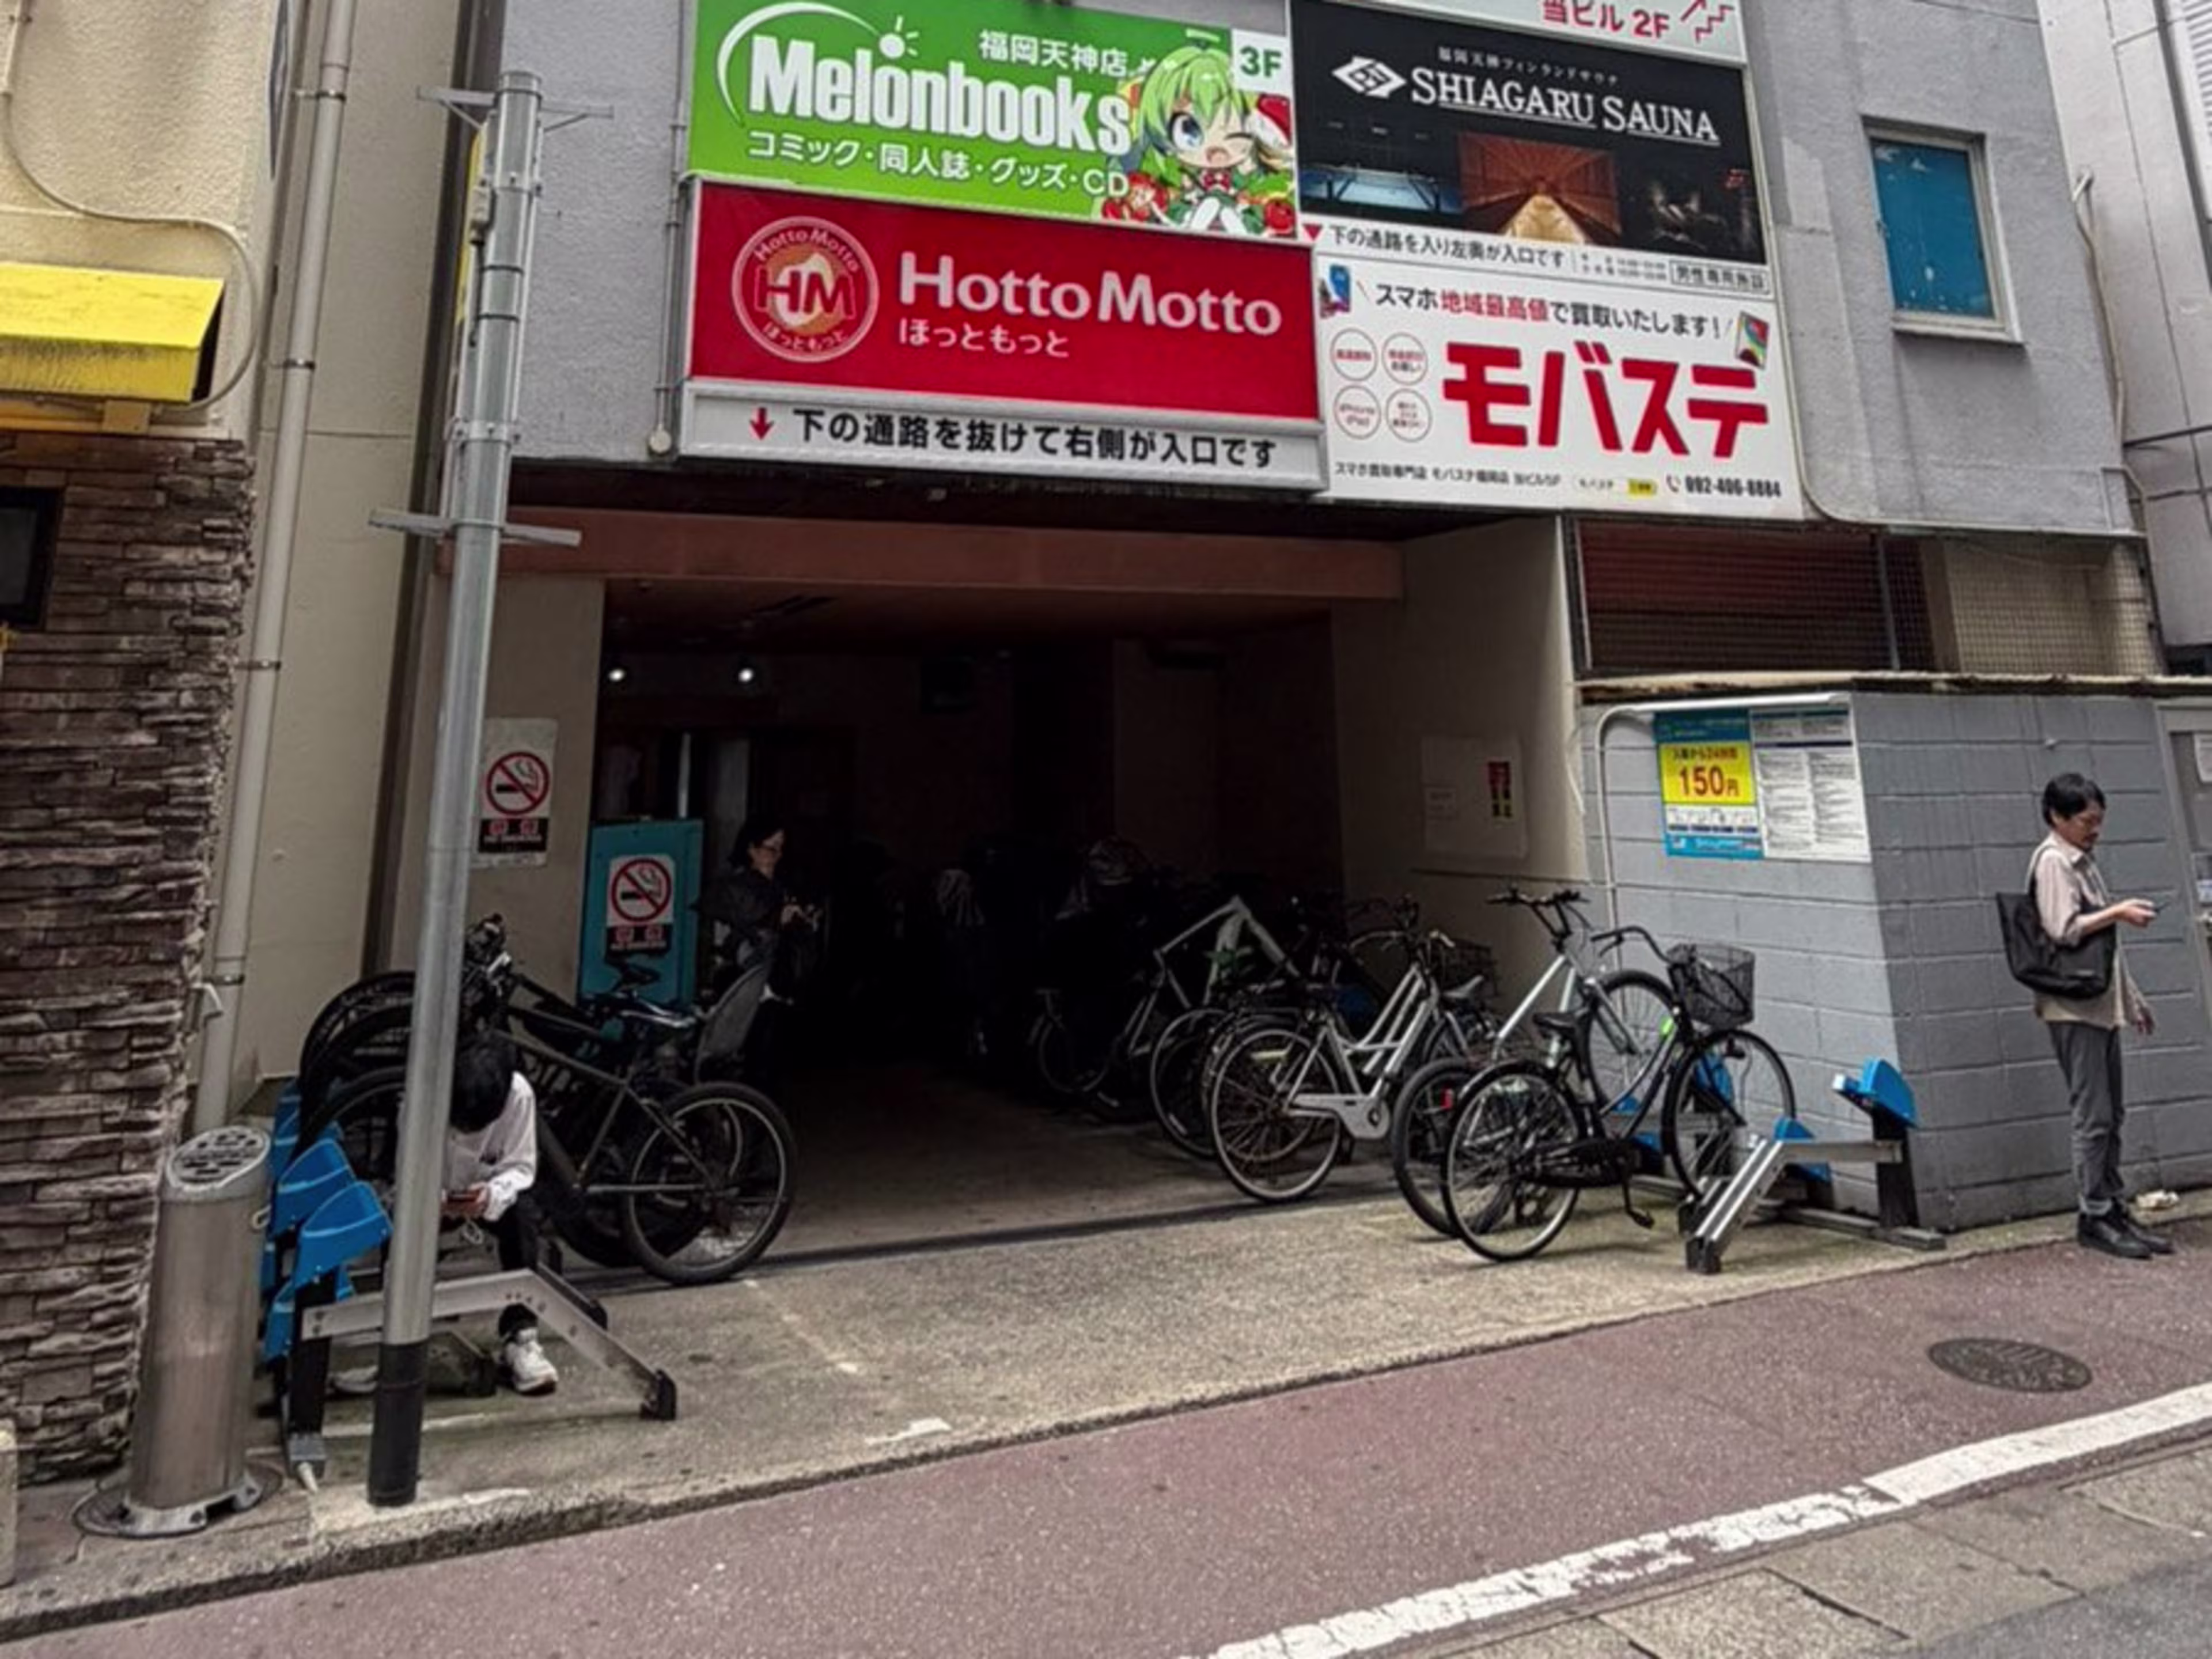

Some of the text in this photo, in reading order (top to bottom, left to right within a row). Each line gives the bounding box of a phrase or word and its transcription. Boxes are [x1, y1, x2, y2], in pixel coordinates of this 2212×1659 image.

[1543, 0, 1670, 38] 当ビル 2F
[979, 29, 1128, 77] 福岡天神店
[1240, 46, 1282, 78] 3F
[749, 34, 1130, 156] Melonbooks
[1411, 67, 1720, 142] SHIAGARU SAUNA
[749, 129, 1130, 197] コミック・同人誌・グッズ・CD
[753, 228, 860, 273] Hotto Motto
[755, 264, 857, 320] HM
[899, 252, 1282, 336] Hotto Motto
[899, 317, 1069, 358] ほっともっと
[1442, 340, 1769, 459] モバステ
[793, 408, 1277, 468] 下の通路を抜けて右側が入口です
